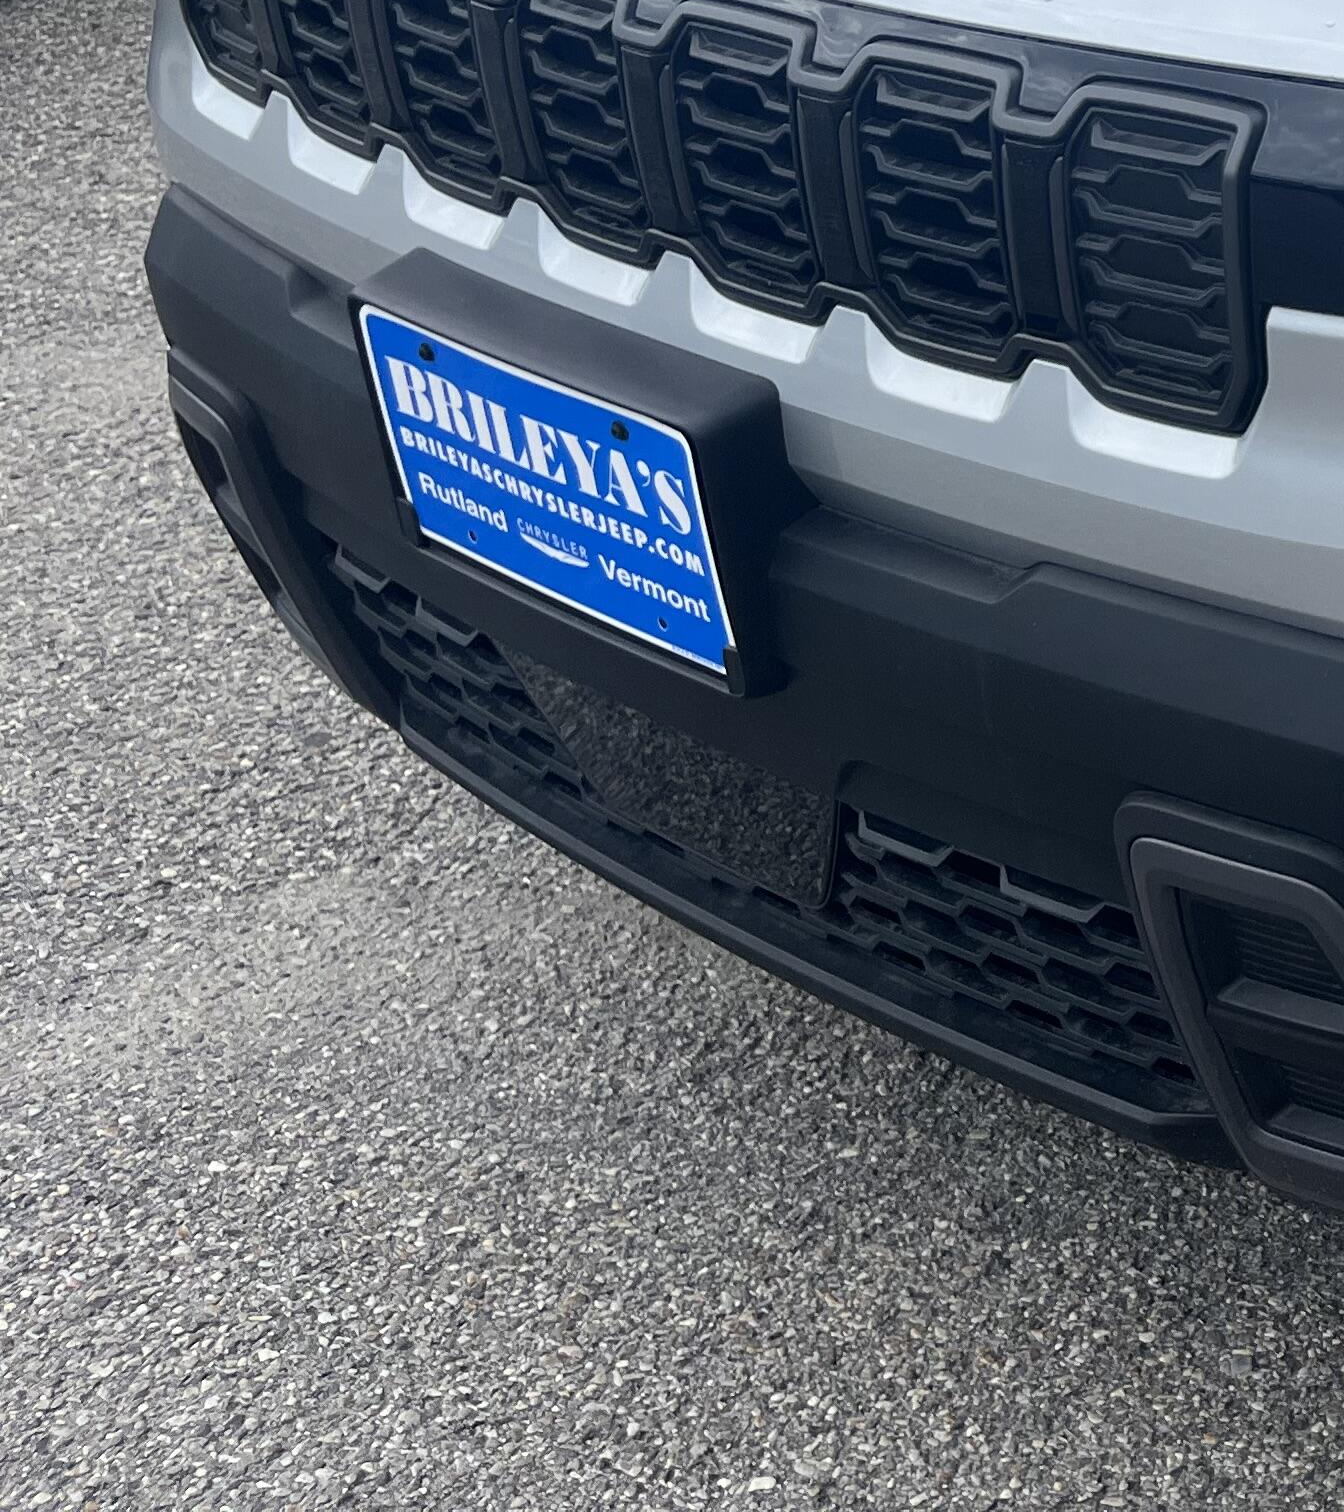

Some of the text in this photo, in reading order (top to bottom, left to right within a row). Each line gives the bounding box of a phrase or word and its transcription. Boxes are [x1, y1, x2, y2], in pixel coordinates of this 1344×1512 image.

[384, 355, 692, 536] BRILEYA'S
[400, 425, 705, 577] BRILEYASCHRYSLERJEEP.COM
[418, 472, 711, 623] Rutland CHRYSLER Vermont
